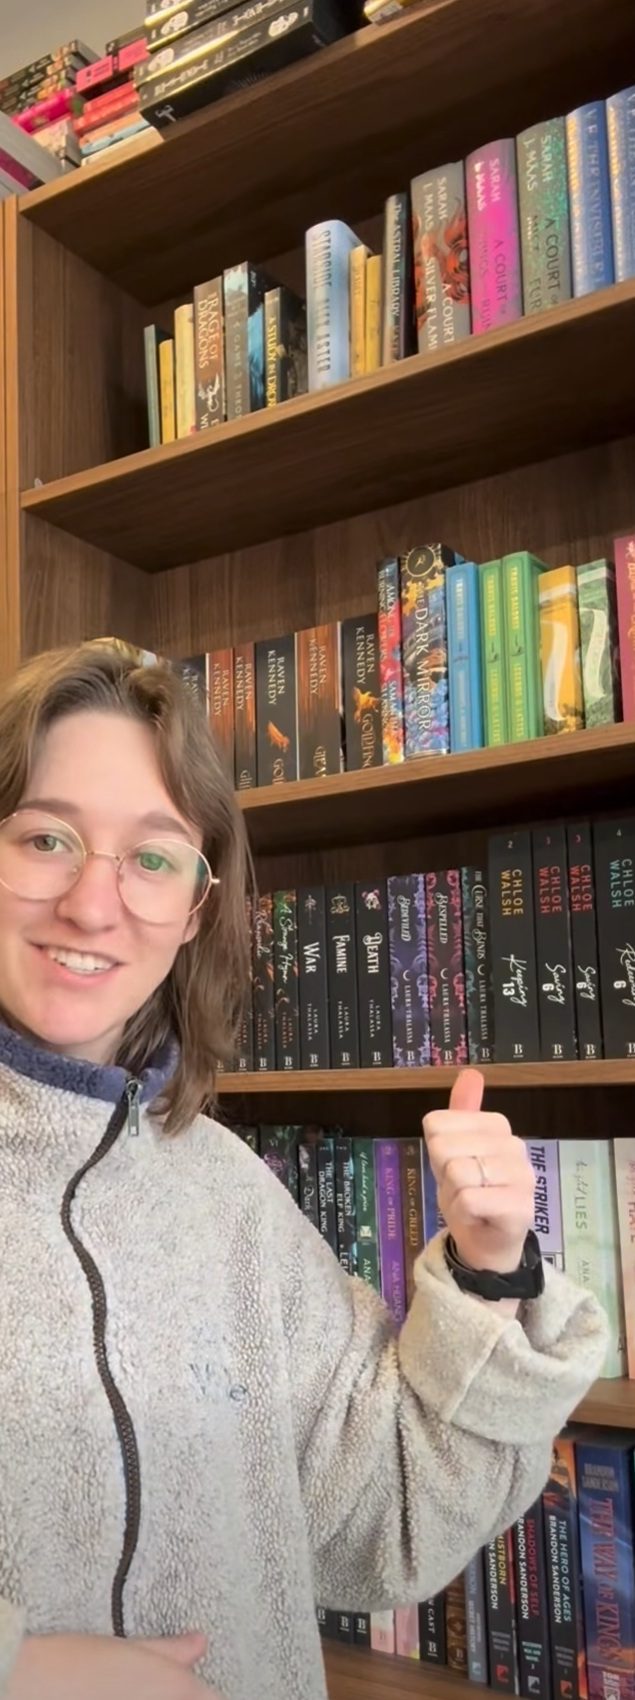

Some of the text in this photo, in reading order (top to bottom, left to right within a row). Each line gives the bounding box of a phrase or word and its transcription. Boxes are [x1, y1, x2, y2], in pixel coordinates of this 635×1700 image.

[526, 152, 538, 192] MAAS
[541, 134, 553, 183] SARAH
[437, 176, 449, 220] SARAH
[488, 158, 502, 203] SARAH
[423, 194, 434, 231] MAAS
[423, 257, 437, 307] SILVER
[494, 255, 508, 302] COURT
[546, 234, 560, 290] COURT
[198, 300, 209, 369] DRAGONS
[208, 300, 219, 341] RAGE
[442, 296, 456, 344] COURT
[308, 637, 318, 696] KENNEDY
[318, 645, 327, 685] RAVEN
[355, 626, 366, 685] KENNEDY
[366, 633, 375, 674] RAVEN
[415, 608, 432, 732] DARK MIRROR
[213, 663, 221, 718] KENNEDY
[221, 668, 229, 707] RAVEN
[236, 656, 244, 711] KENNEDY
[244, 663, 252, 700] RAVEN
[267, 650, 277, 706] KENNEDY
[276, 656, 286, 695] RAVEN
[501, 870, 511, 916] WALSH
[512, 869, 523, 915] CHLOE
[539, 866, 549, 914] WALSH
[550, 866, 561, 913] CHLOE
[570, 865, 581, 912] WALSH
[581, 864, 592, 911] CHLOE
[610, 860, 622, 908] WALSH
[622, 858, 634, 906] CHLOE
[303, 941, 320, 974] WAR
[332, 934, 350, 974] FAMINE
[362, 932, 382, 974] DEATH
[472, 928, 487, 959] BINDS
[501, 954, 527, 1008] Keeping
[502, 982, 515, 996] 13
[542, 983, 554, 991] 6
[545, 962, 566, 1004] Saving
[576, 982, 587, 990] 6
[577, 965, 596, 1000] Saving
[613, 980, 626, 989] 6
[405, 1011, 413, 1044] THALASSA
[442, 1011, 450, 1044] THALASSA
[479, 1005, 488, 1040] THALASSA
[304, 1186, 314, 1211] Dark
[326, 1182, 334, 1203] LAST
[384, 1168, 393, 1195] KING
[407, 1168, 415, 1196] KING
[530, 1146, 549, 1235] THE STRIKER
[387, 1208, 396, 1240] PRIDE
[410, 1209, 418, 1246] GREED
[574, 1196, 588, 1230] LIES
[581, 1259, 590, 1283] ANA
[590, 1498, 613, 1536] THE
[489, 1551, 498, 1610] SANDERSON
[527, 1518, 540, 1617] SHADOWS OF SELF
[548, 1514, 562, 1624] BRANDON SANDERSON
[558, 1520, 571, 1623] THE HERO OF AGES
[592, 1543, 618, 1582] WAY
[519, 1562, 530, 1620] SANDERSON
[427, 1607, 436, 1634] CAST
[596, 1602, 622, 1662] KINGS
